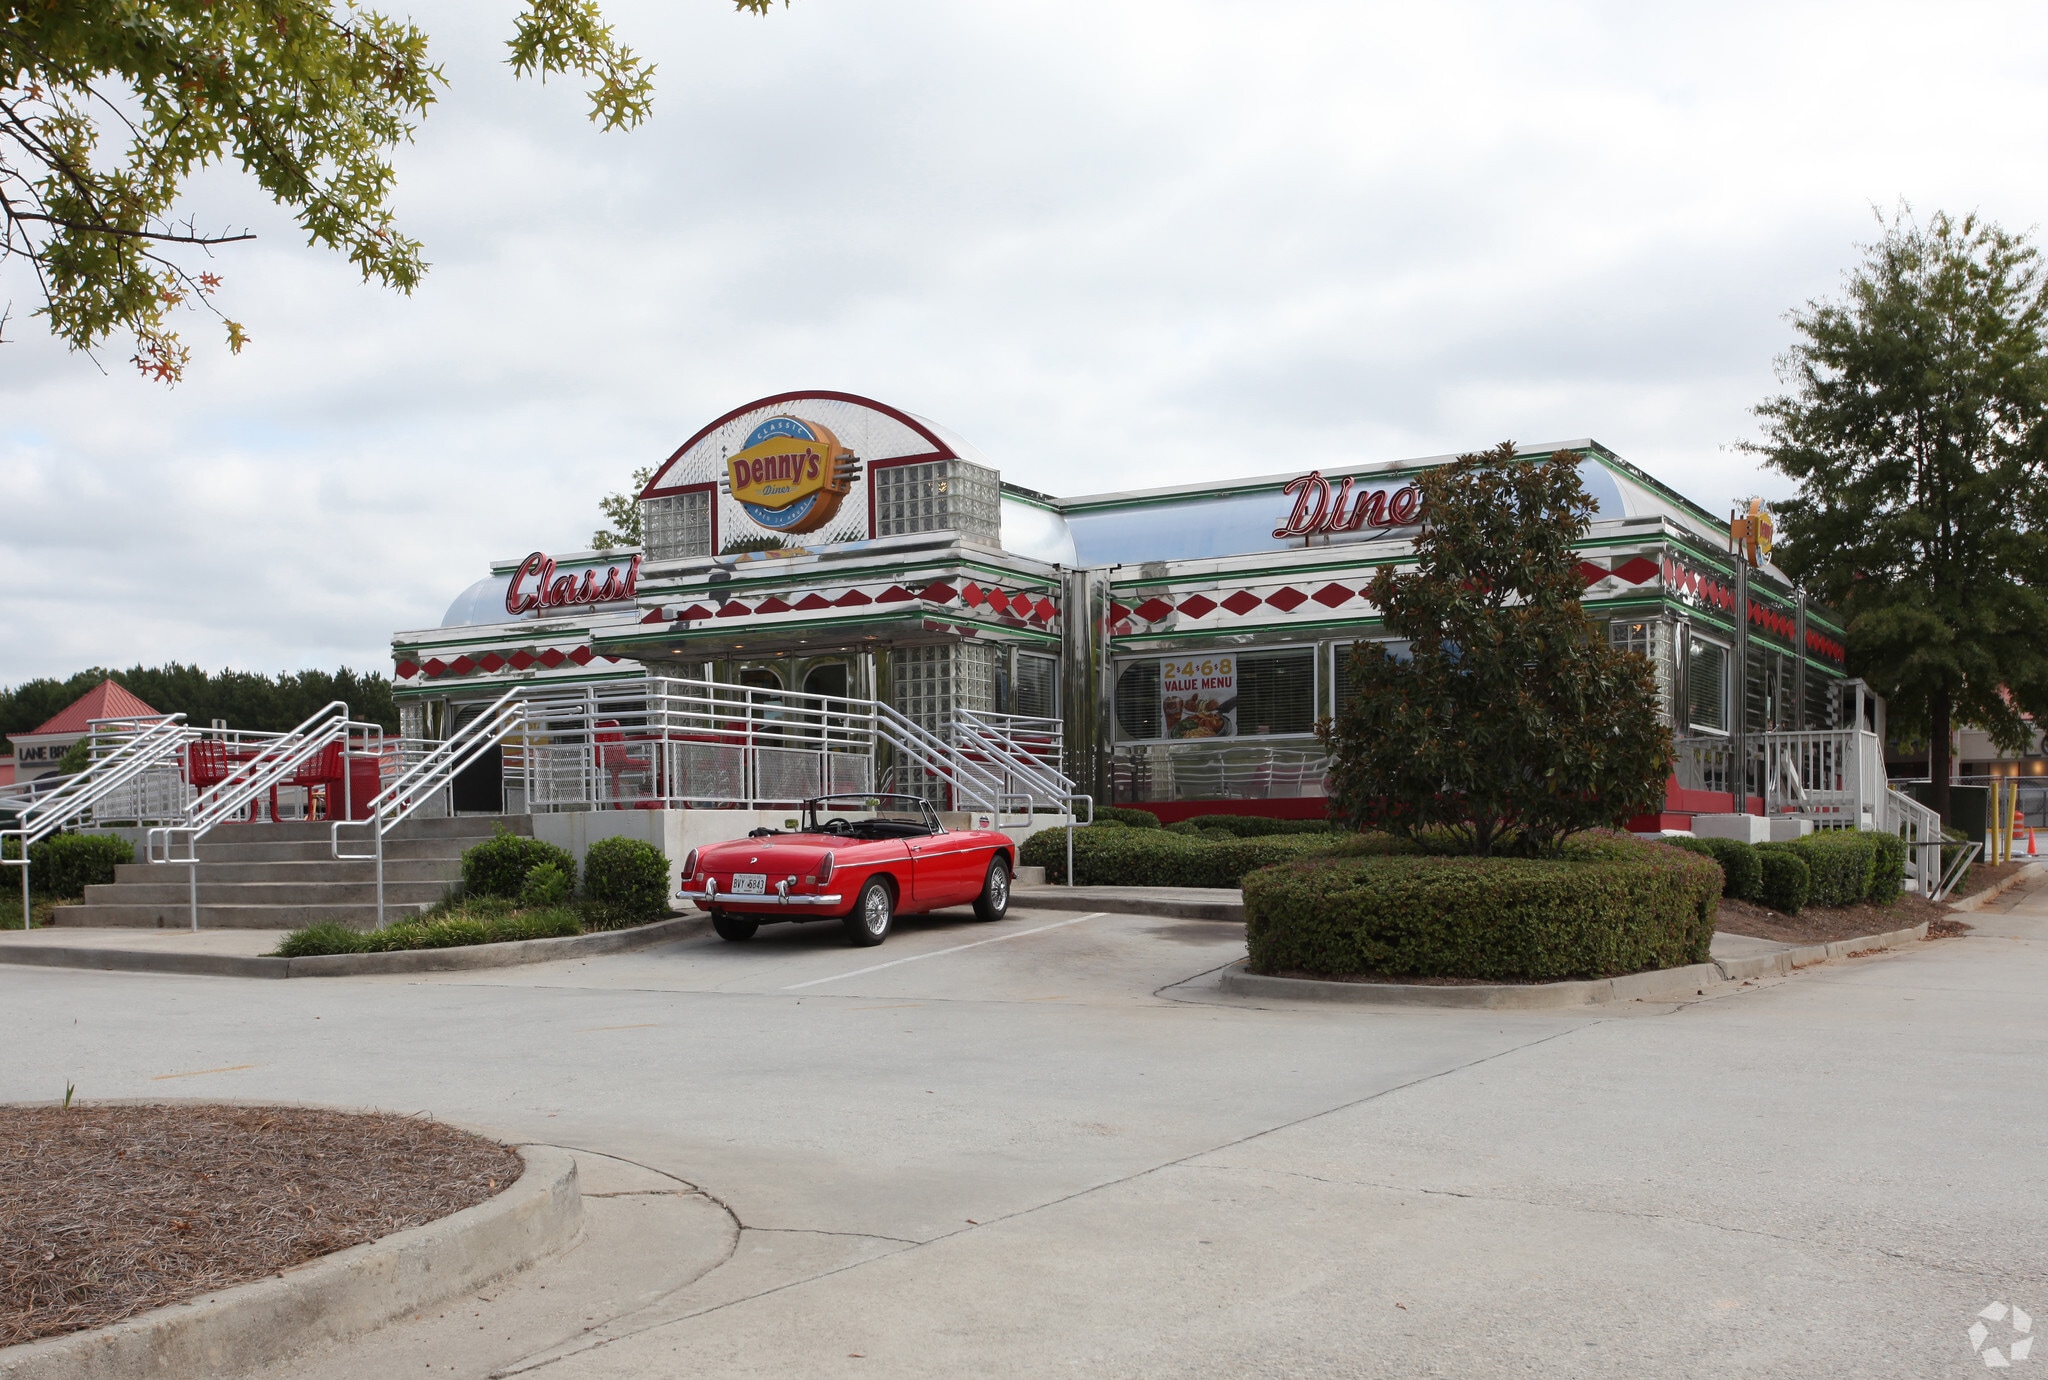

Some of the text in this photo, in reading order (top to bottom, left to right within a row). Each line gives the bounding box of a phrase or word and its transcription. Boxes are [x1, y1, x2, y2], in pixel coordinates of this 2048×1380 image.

[757, 421, 803, 439] CLASSIC
[733, 447, 821, 490] Denny's
[761, 485, 791, 496] Diner
[1272, 470, 1421, 539] Dine
[505, 551, 642, 615] Classi
[1164, 676, 1232, 692] VALUE MENU
[19, 744, 72, 761] LANE BRY
